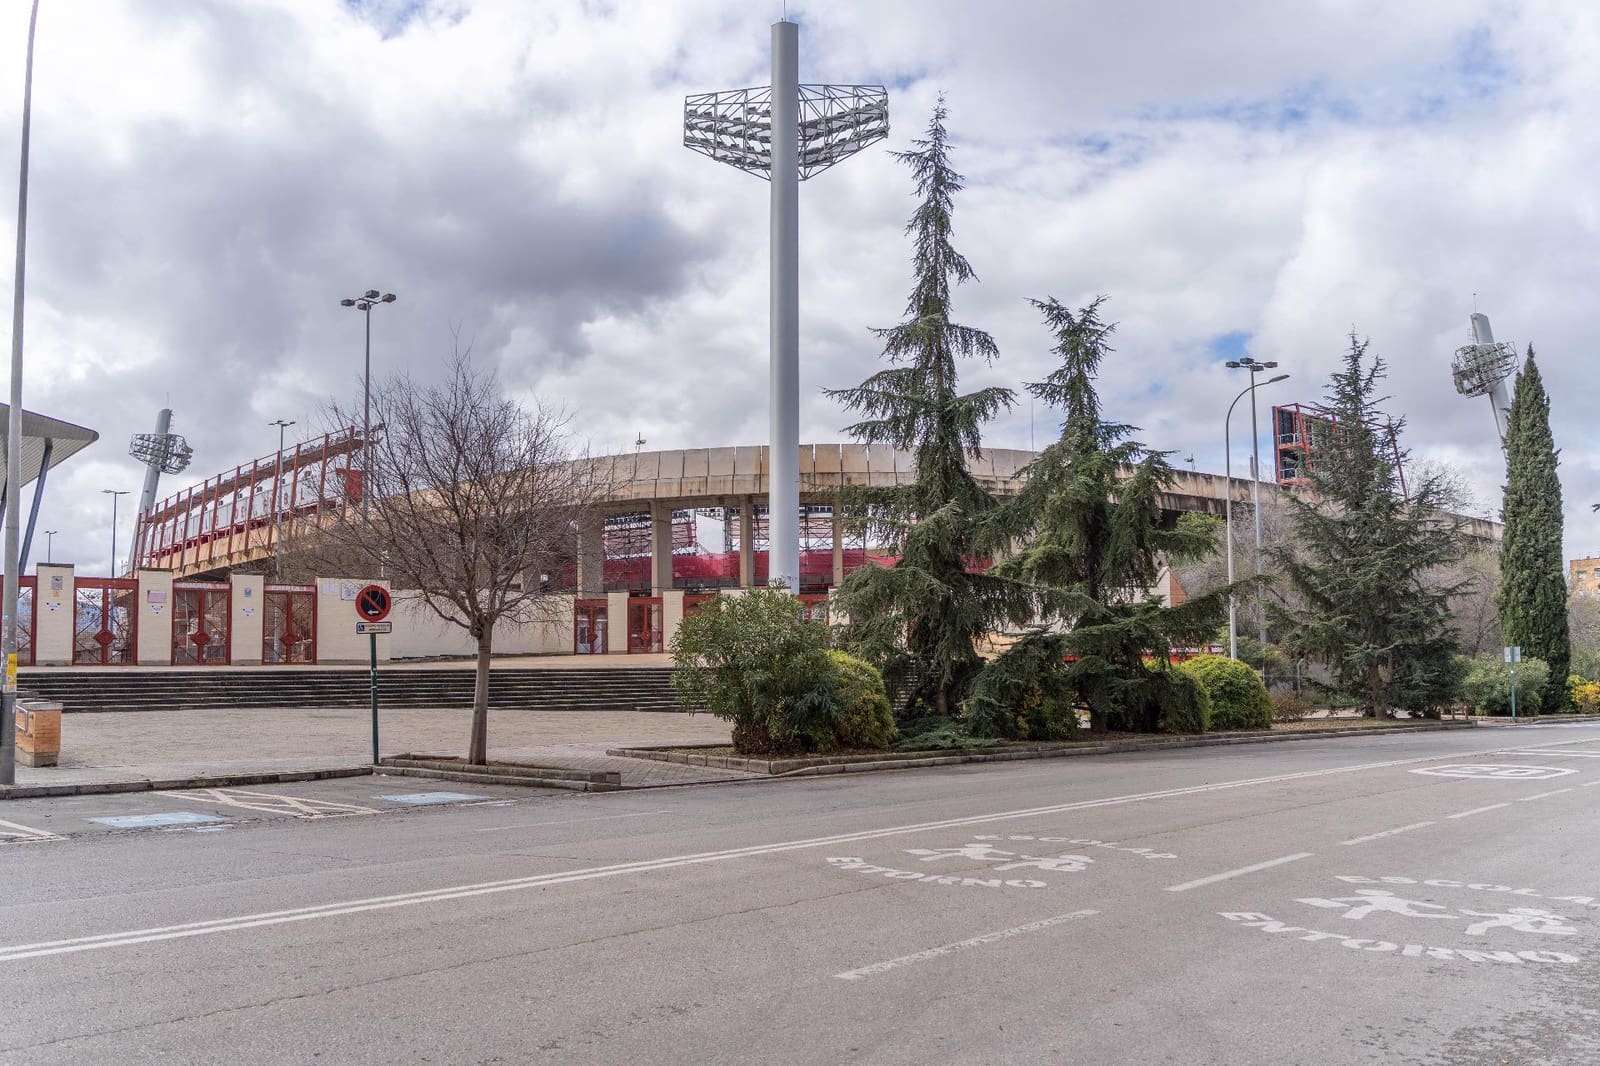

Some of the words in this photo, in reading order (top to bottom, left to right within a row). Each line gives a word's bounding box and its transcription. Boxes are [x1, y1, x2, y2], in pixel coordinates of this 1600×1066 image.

[973, 835, 1178, 859] ESCOLAR
[825, 856, 1048, 888] ENTORNO
[1335, 875, 1600, 907] ESCOLA
[1216, 912, 1580, 963] ENTORNO
